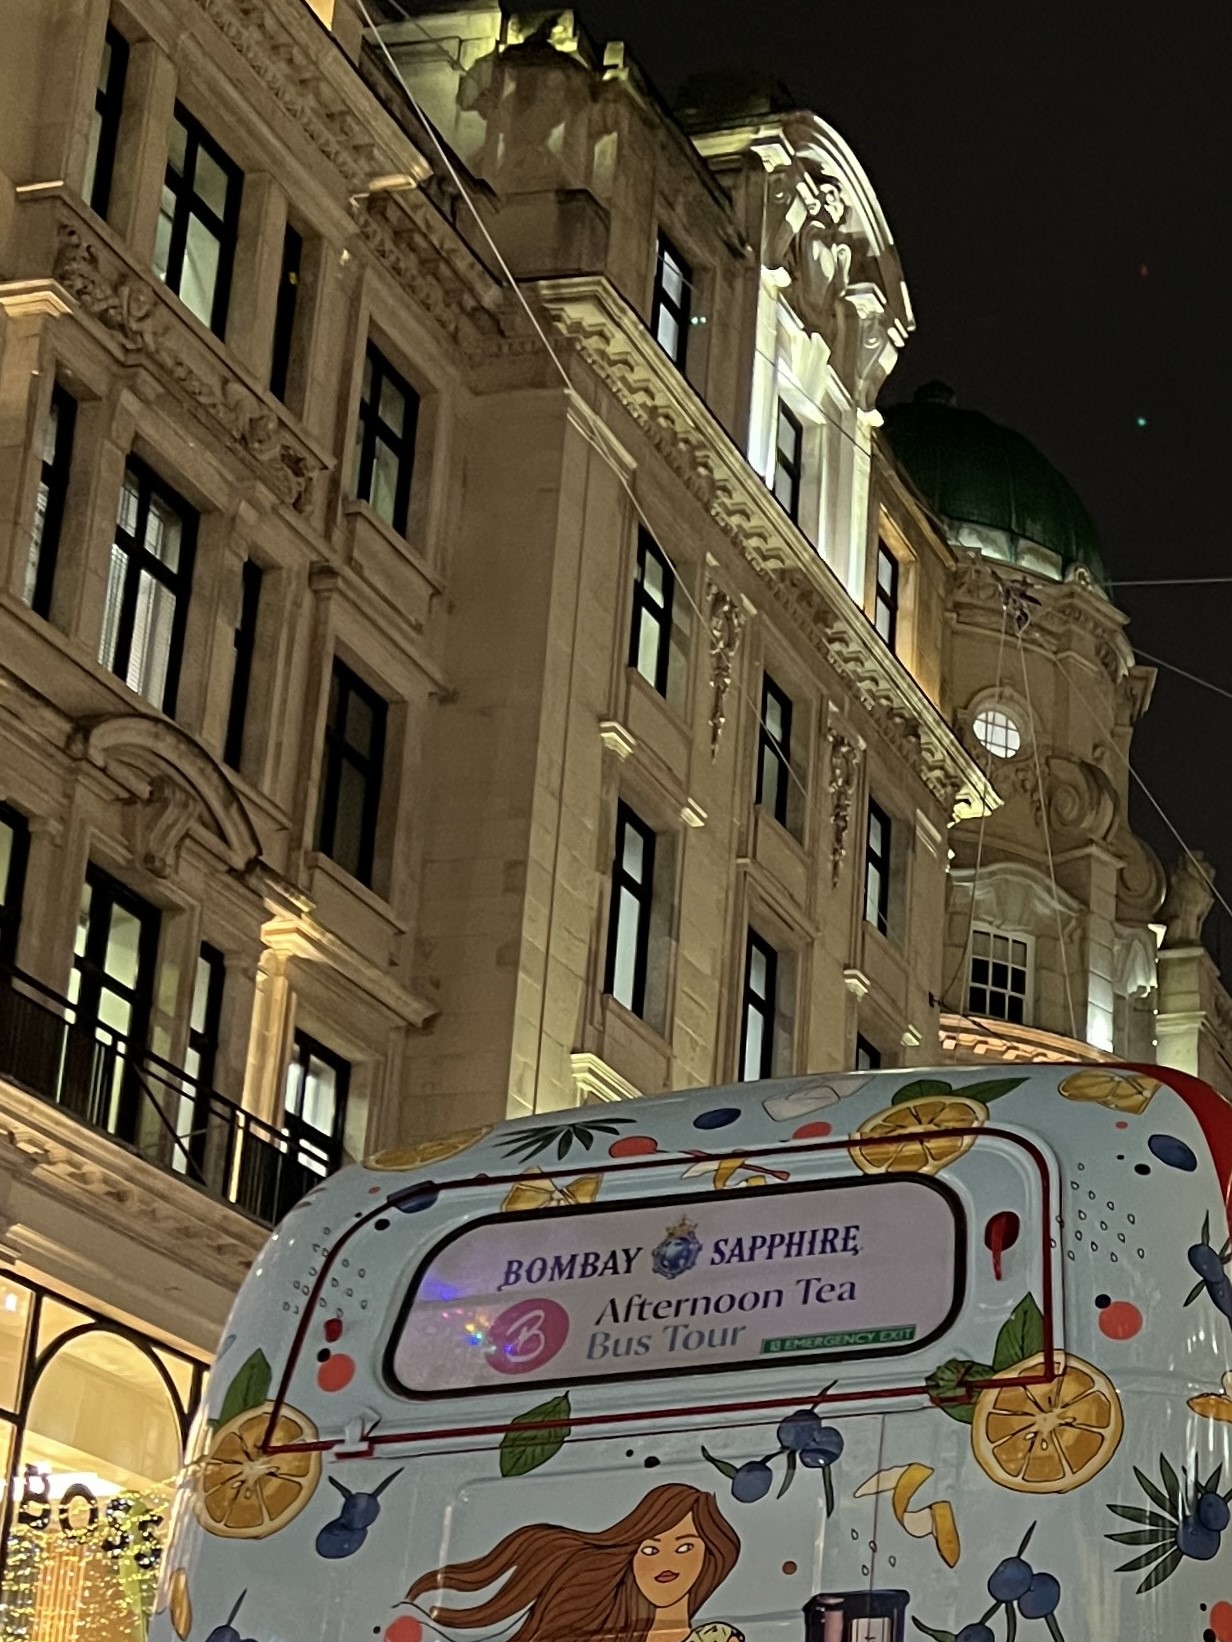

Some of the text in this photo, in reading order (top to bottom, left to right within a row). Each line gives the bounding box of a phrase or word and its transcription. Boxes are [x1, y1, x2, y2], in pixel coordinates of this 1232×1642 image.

[497, 1225, 861, 1291] BOMBAY SAPPHIRE
[595, 1277, 857, 1326] Afternoon Tea
[586, 1323, 747, 1360] Bus Tour
[784, 1328, 913, 1350] EMERGENCY EXIT
